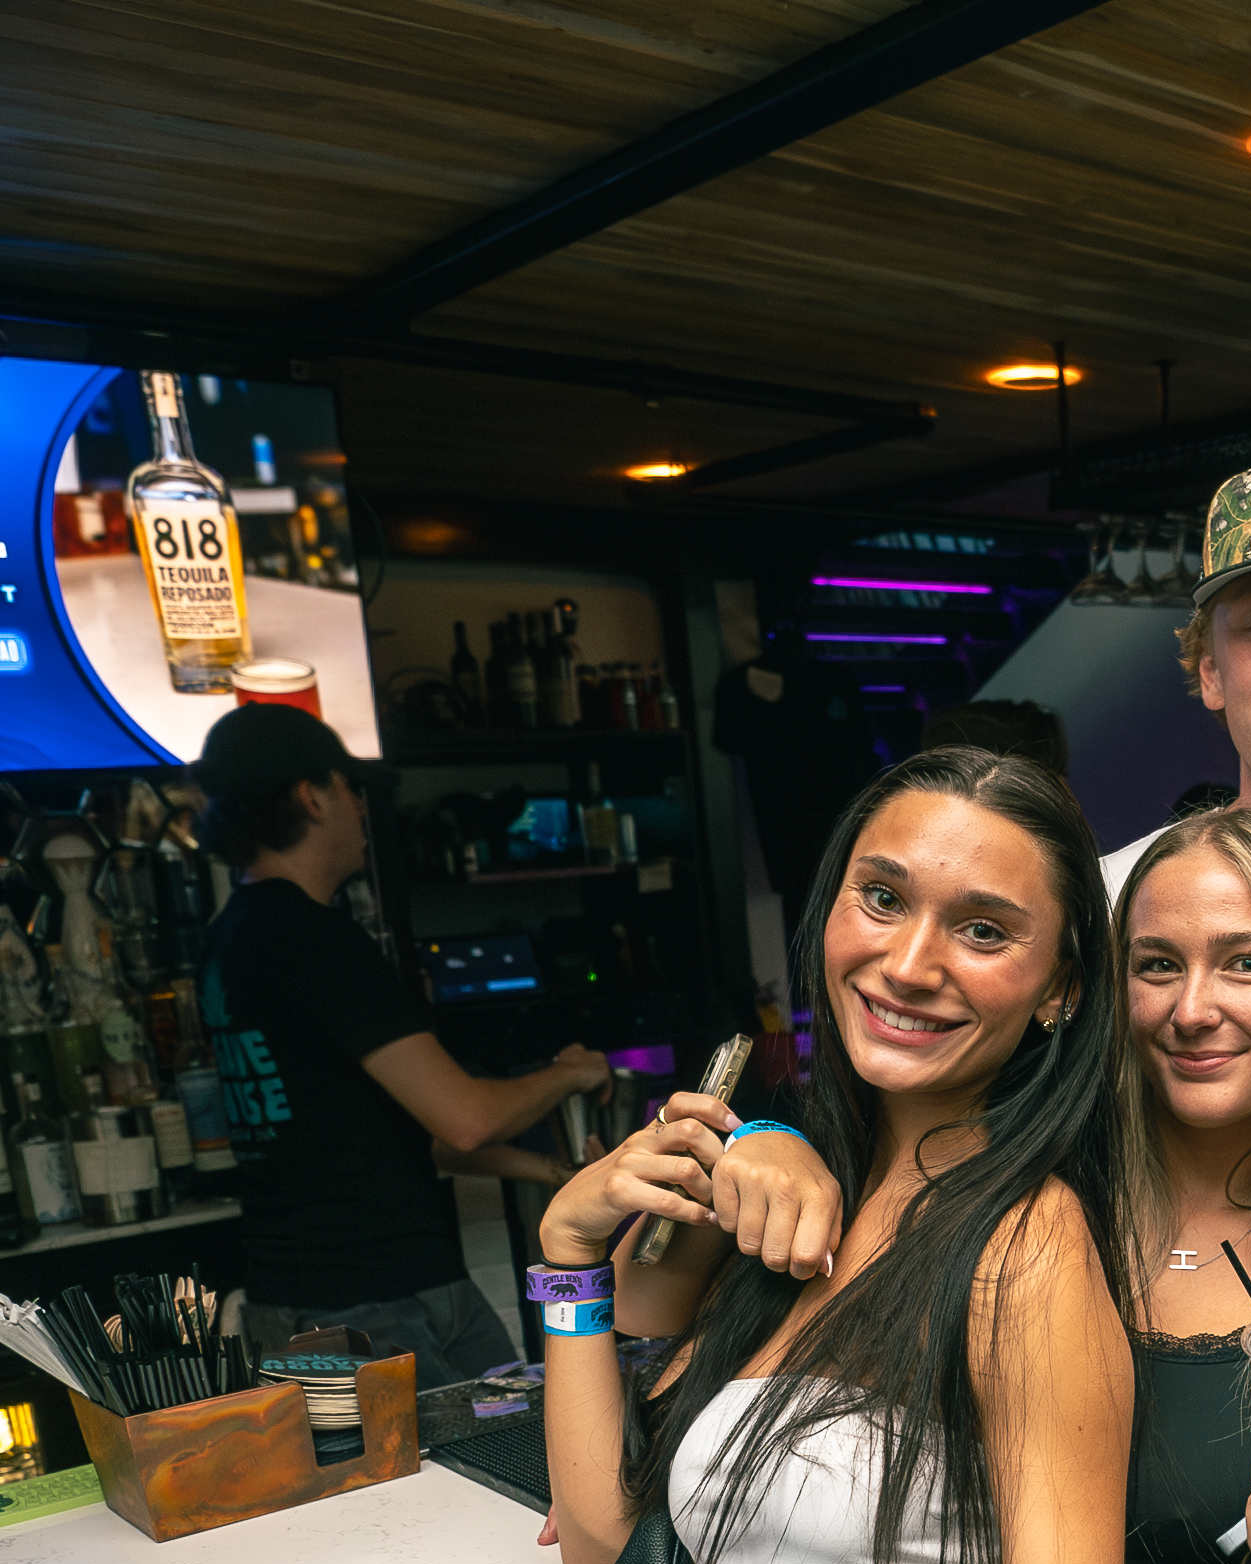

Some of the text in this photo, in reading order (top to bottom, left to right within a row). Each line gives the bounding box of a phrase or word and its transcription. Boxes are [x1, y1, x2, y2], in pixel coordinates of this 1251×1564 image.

[154, 517, 222, 560] 818
[158, 566, 229, 583] TEQUILA
[161, 586, 232, 602] REPOSADO
